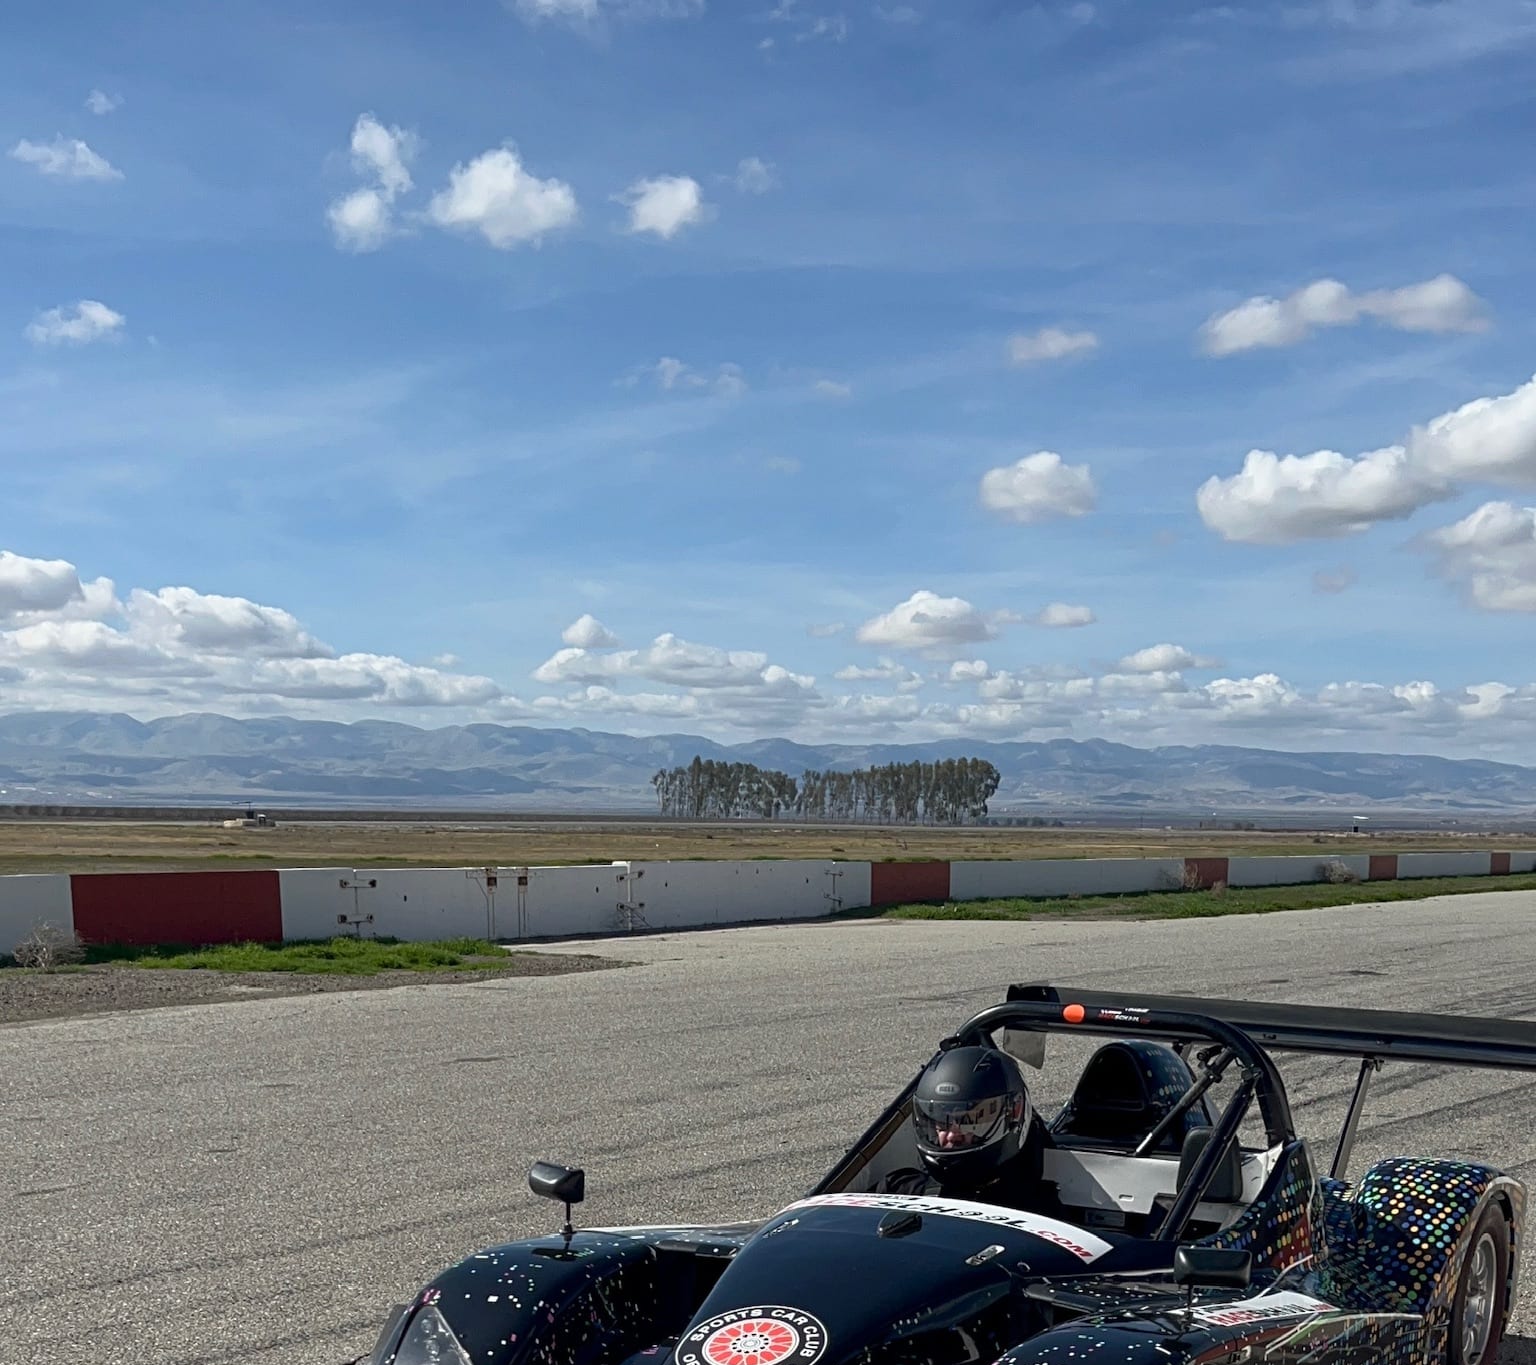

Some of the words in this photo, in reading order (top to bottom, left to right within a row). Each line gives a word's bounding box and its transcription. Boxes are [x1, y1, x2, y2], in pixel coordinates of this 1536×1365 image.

[690, 1308, 763, 1342] SPORTS
[771, 1308, 808, 1326] CAR
[800, 1325, 820, 1358] CLUB
